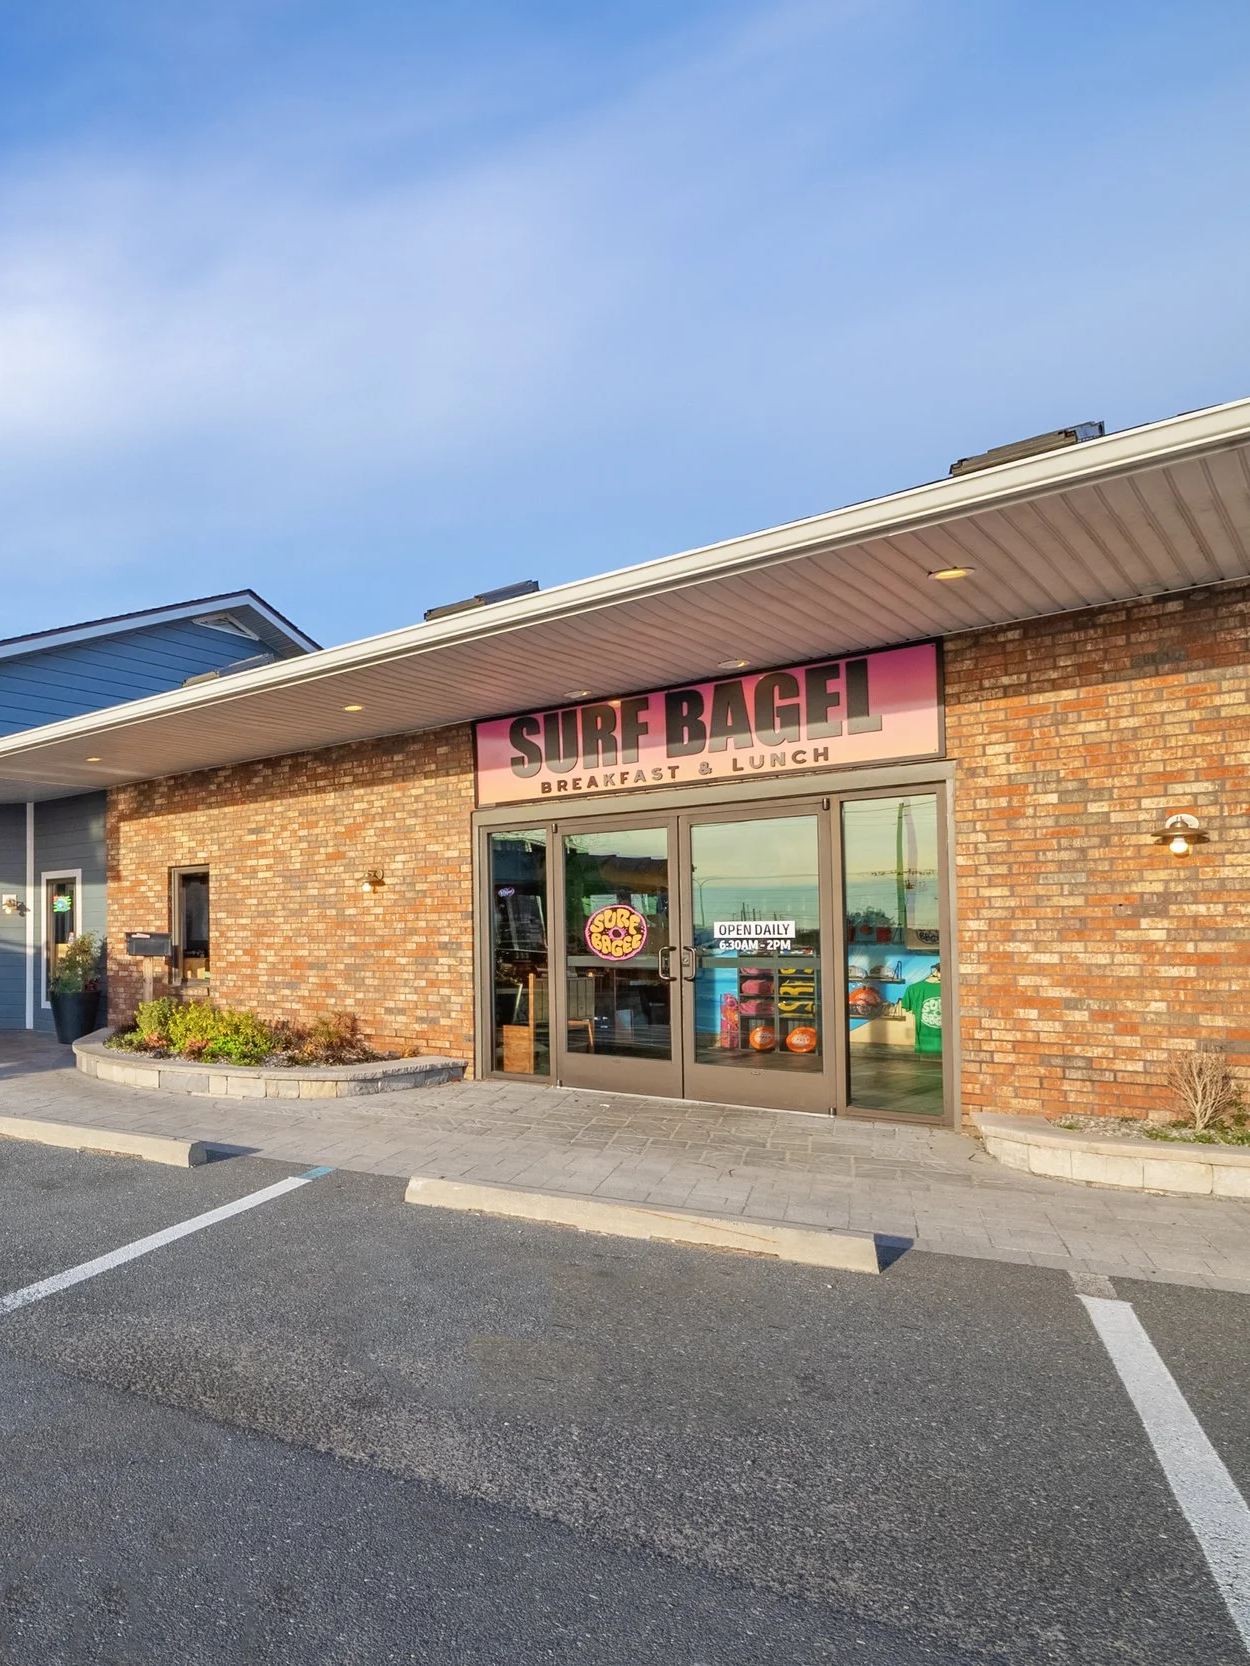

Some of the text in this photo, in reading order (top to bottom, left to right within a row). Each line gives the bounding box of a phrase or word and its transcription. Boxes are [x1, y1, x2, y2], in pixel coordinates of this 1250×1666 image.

[509, 658, 882, 779] SURF BAGEL
[541, 746, 829, 794] BREAKFAST & LUNCH
[590, 908, 641, 934] SURF
[719, 924, 790, 936] OPEN DAILY
[591, 932, 642, 957] BAGEL
[719, 940, 758, 951] 6:30AM
[766, 940, 791, 950] 2PM
